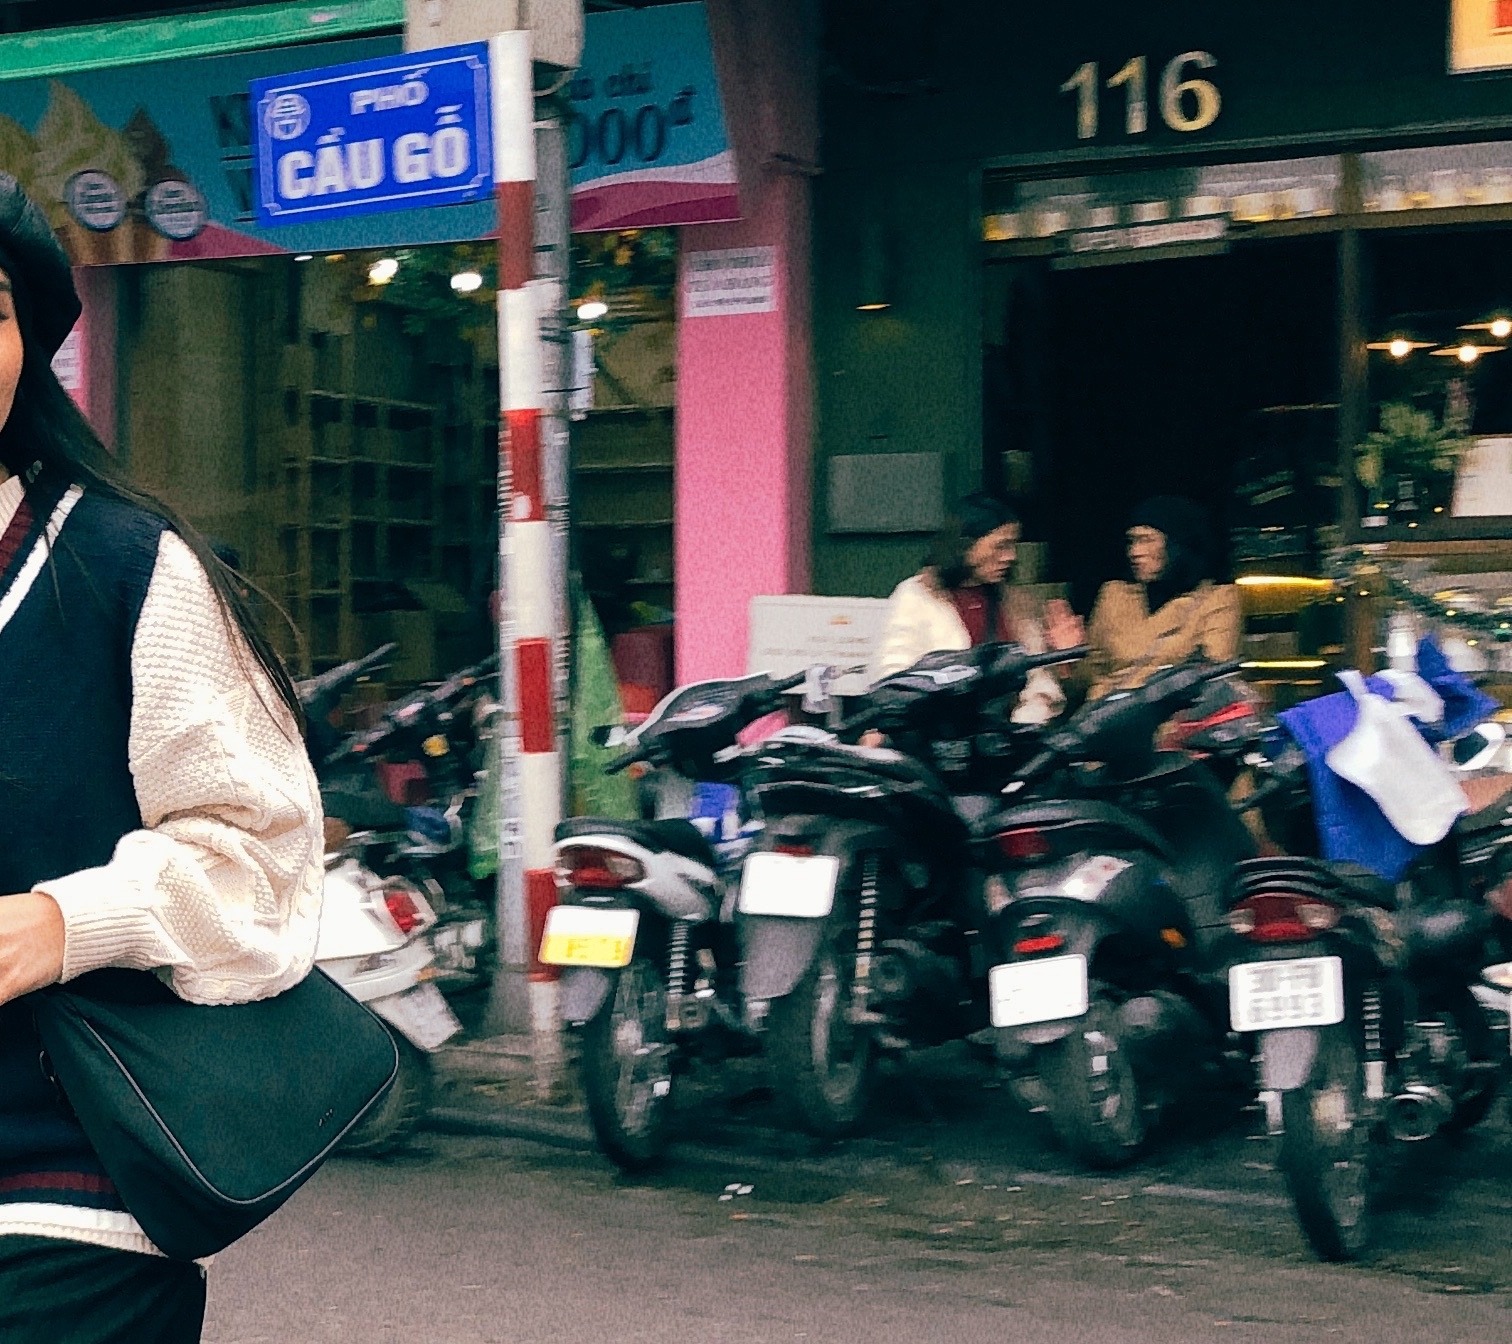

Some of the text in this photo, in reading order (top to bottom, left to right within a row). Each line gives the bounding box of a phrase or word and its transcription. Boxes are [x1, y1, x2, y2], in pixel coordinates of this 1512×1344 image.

[349, 67, 431, 116] PHỐ
[1060, 50, 1222, 140] 116
[277, 127, 385, 200] CẦU
[392, 103, 472, 184] GỖ
